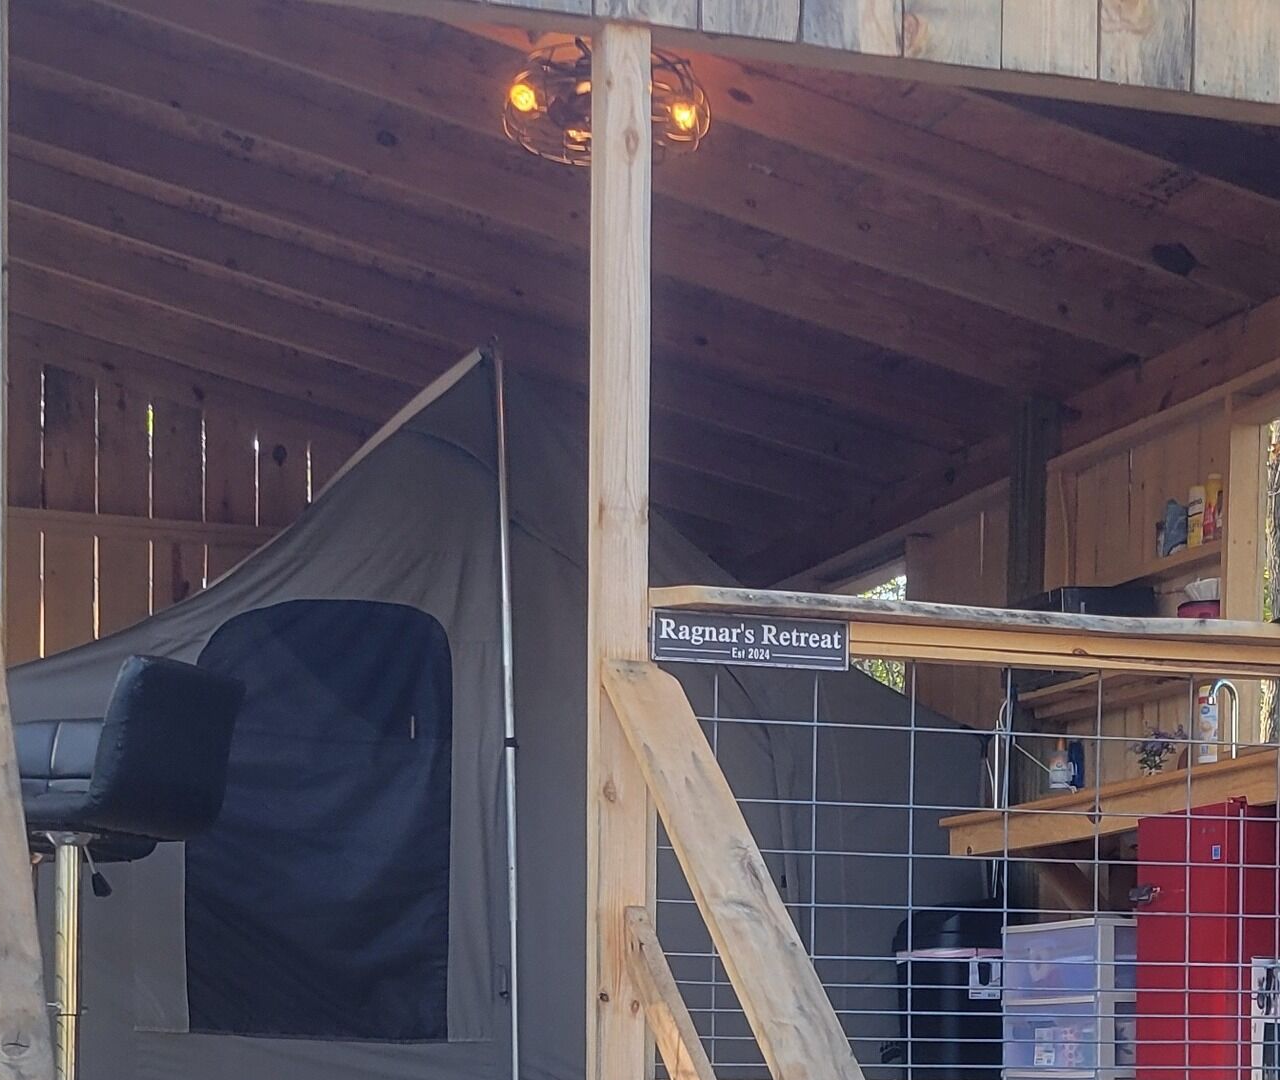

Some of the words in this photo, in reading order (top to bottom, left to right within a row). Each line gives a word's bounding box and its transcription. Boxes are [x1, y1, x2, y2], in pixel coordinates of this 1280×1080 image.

[659, 618, 755, 645] Ragnar's
[761, 624, 841, 649] Retreat
[732, 647, 745, 658] Est
[748, 648, 770, 660] 2024
